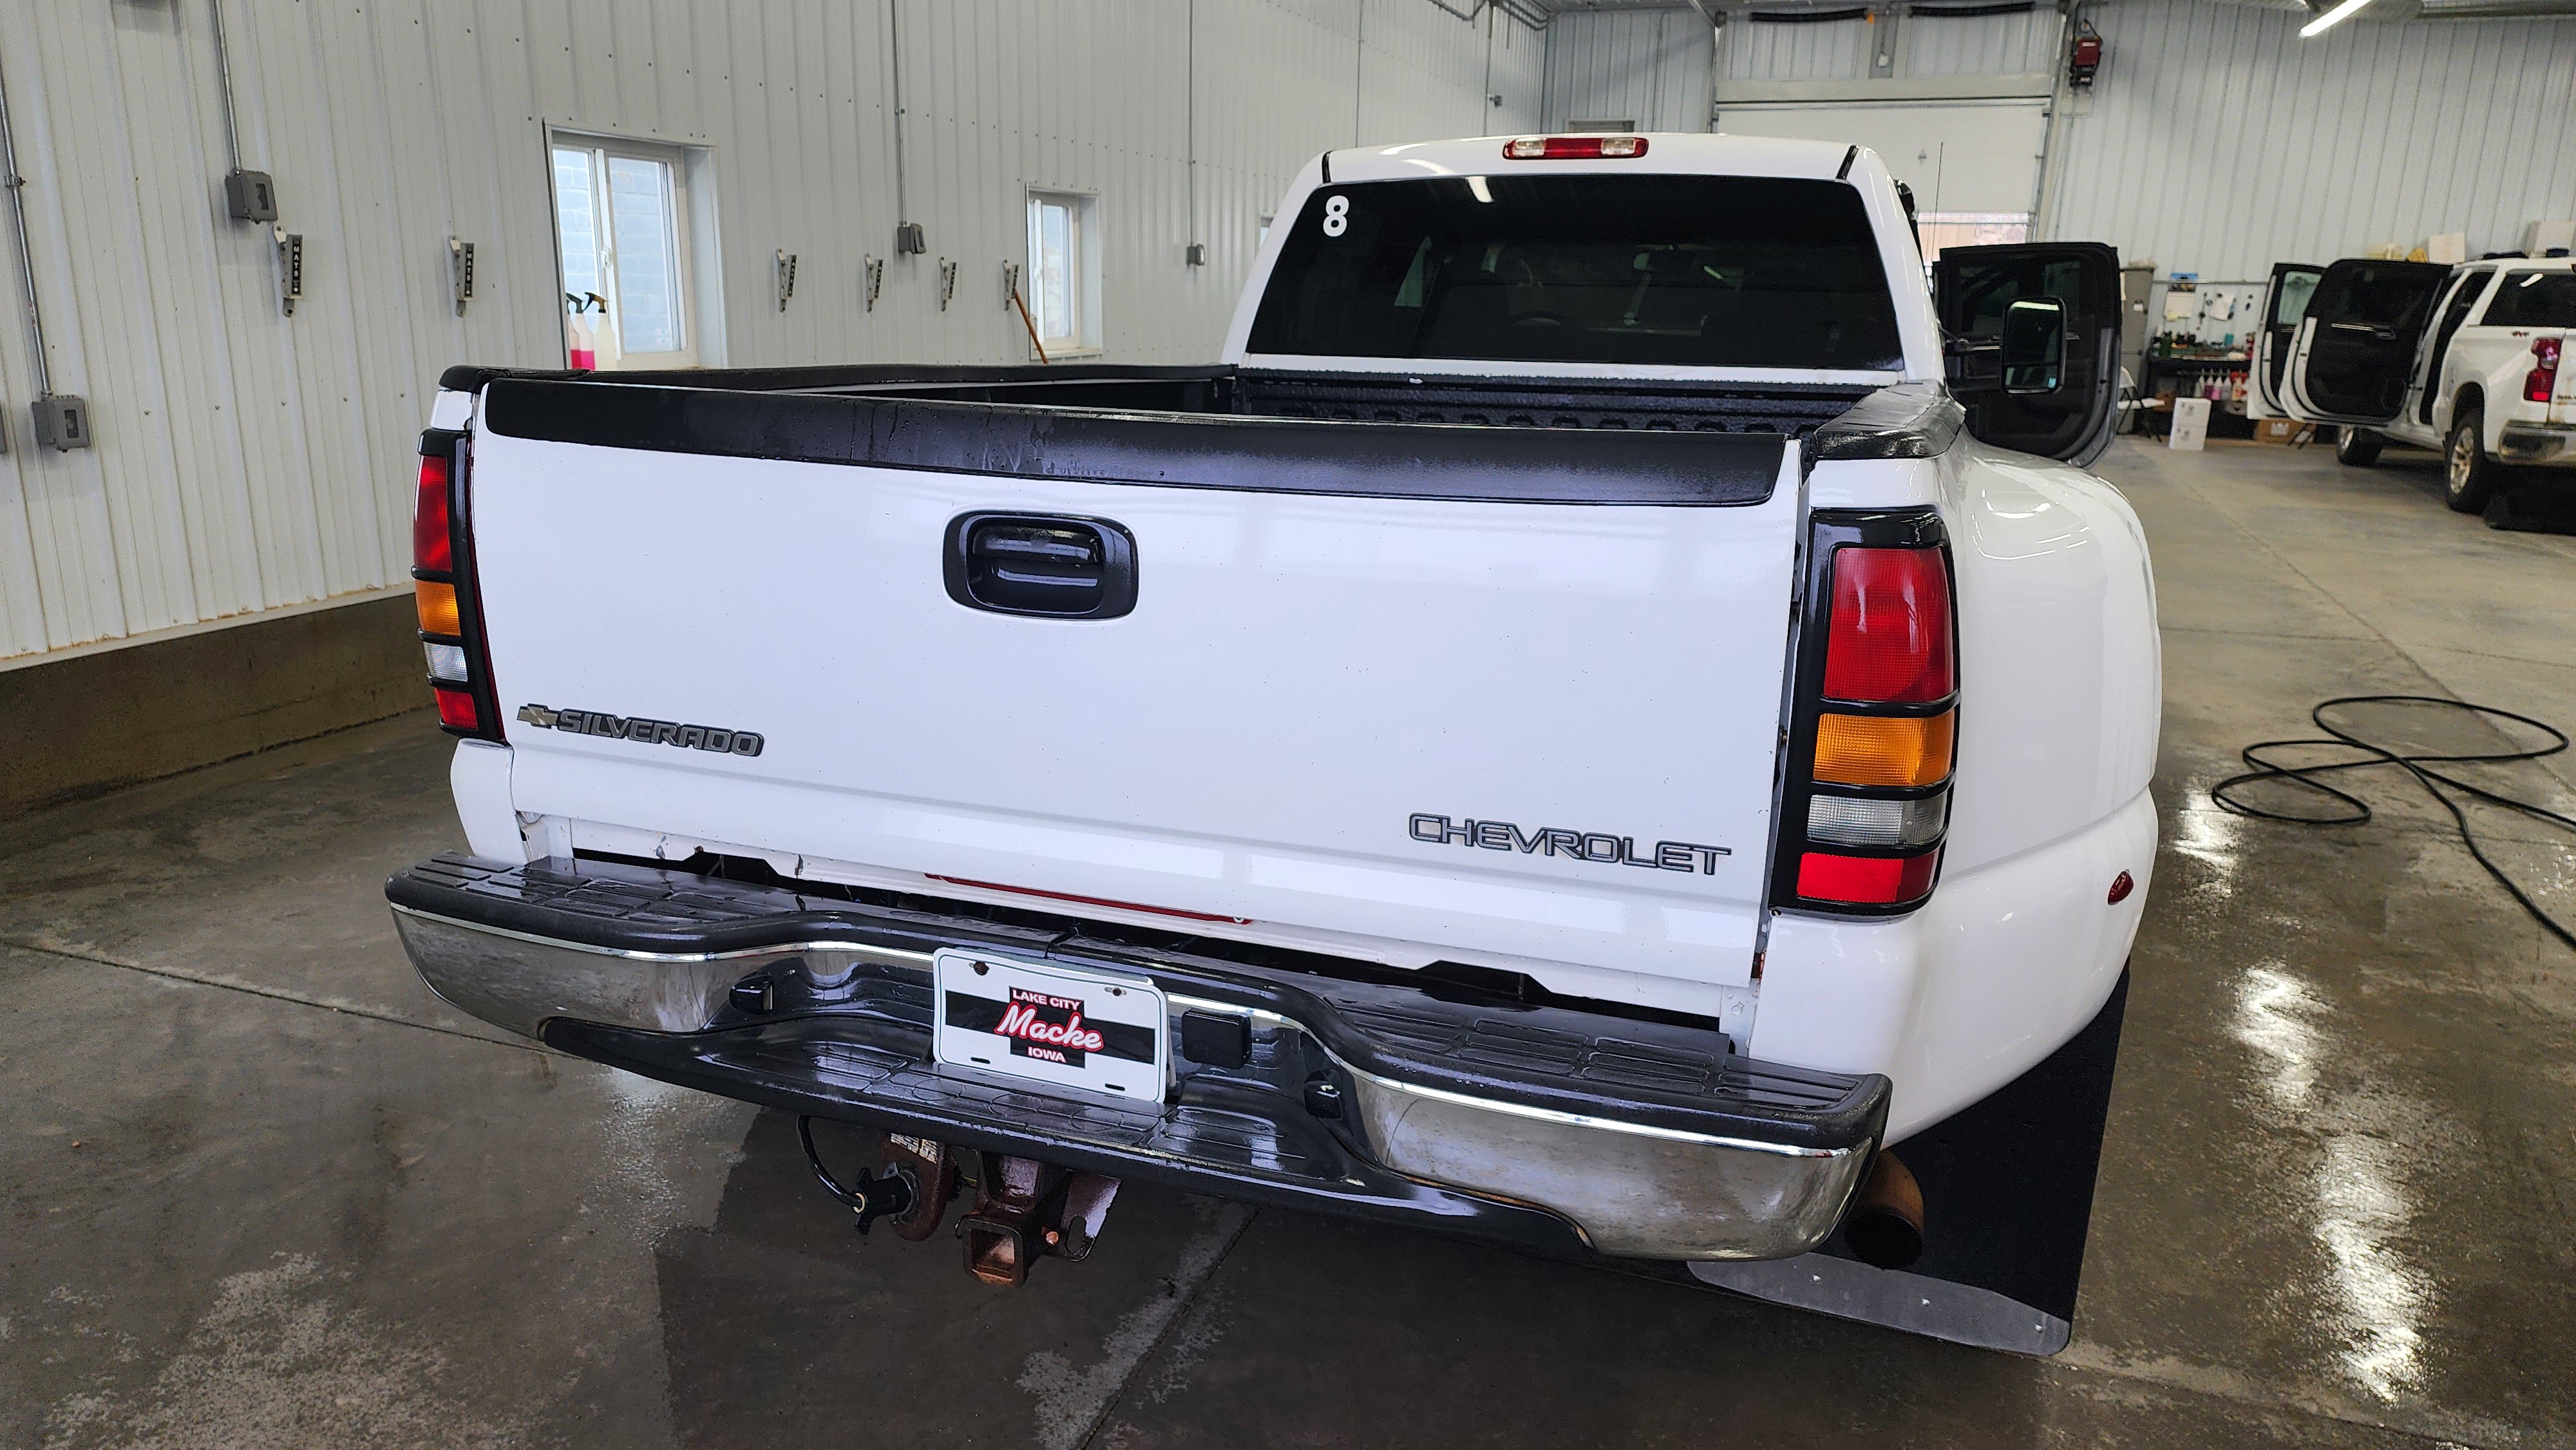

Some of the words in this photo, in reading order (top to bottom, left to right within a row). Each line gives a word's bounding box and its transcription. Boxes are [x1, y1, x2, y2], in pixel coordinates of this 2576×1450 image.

[1323, 195, 1349, 237] 8
[558, 708, 764, 757] SILVERADO
[1409, 813, 1732, 875] CHEVROLET
[1012, 988, 1048, 1006] LAKE
[1049, 997, 1081, 1011] CITY
[995, 1001, 1104, 1051] Macke
[1028, 1045, 1067, 1063] IOWA
